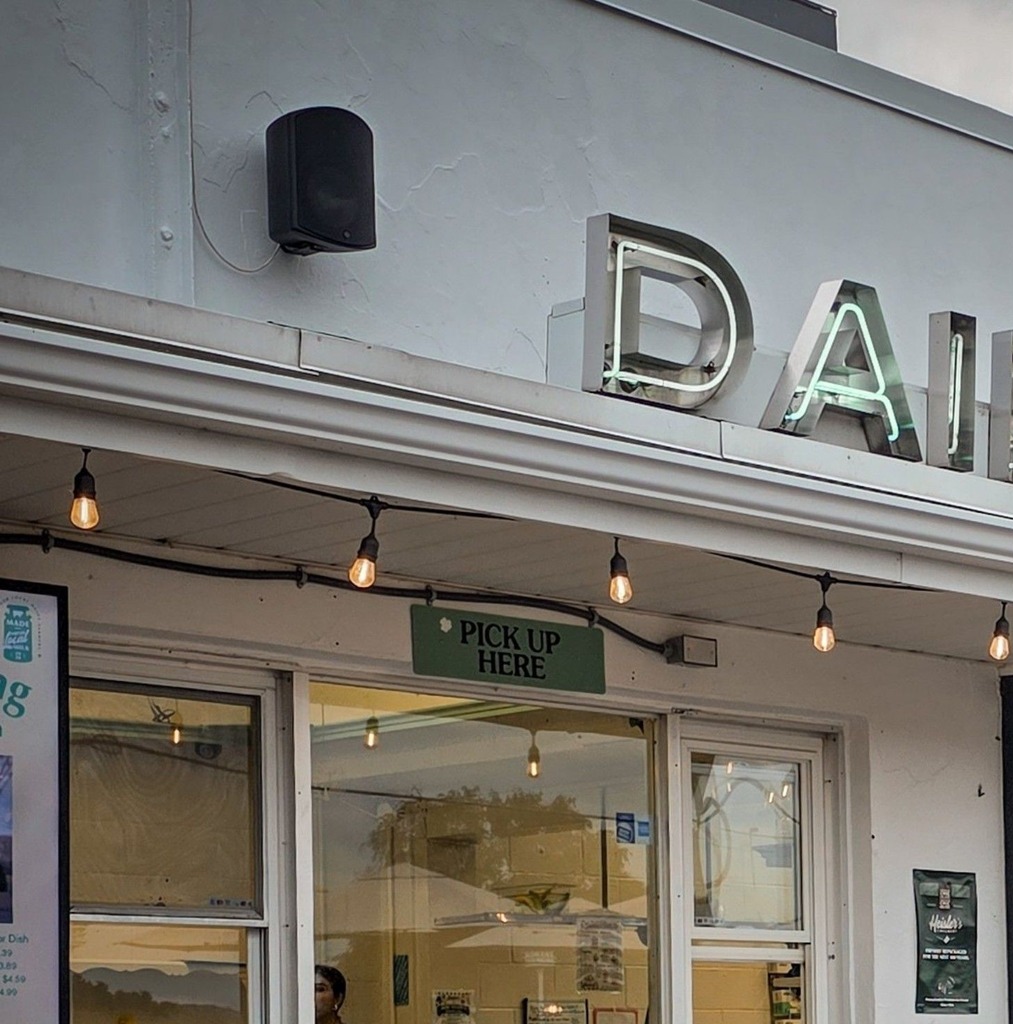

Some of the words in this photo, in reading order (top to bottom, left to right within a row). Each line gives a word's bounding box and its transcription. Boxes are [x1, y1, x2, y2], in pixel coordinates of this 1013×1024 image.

[460, 619, 521, 651] PICK
[527, 628, 561, 654] UP
[478, 649, 546, 679] HERE
[8, 934, 29, 943] Dish
